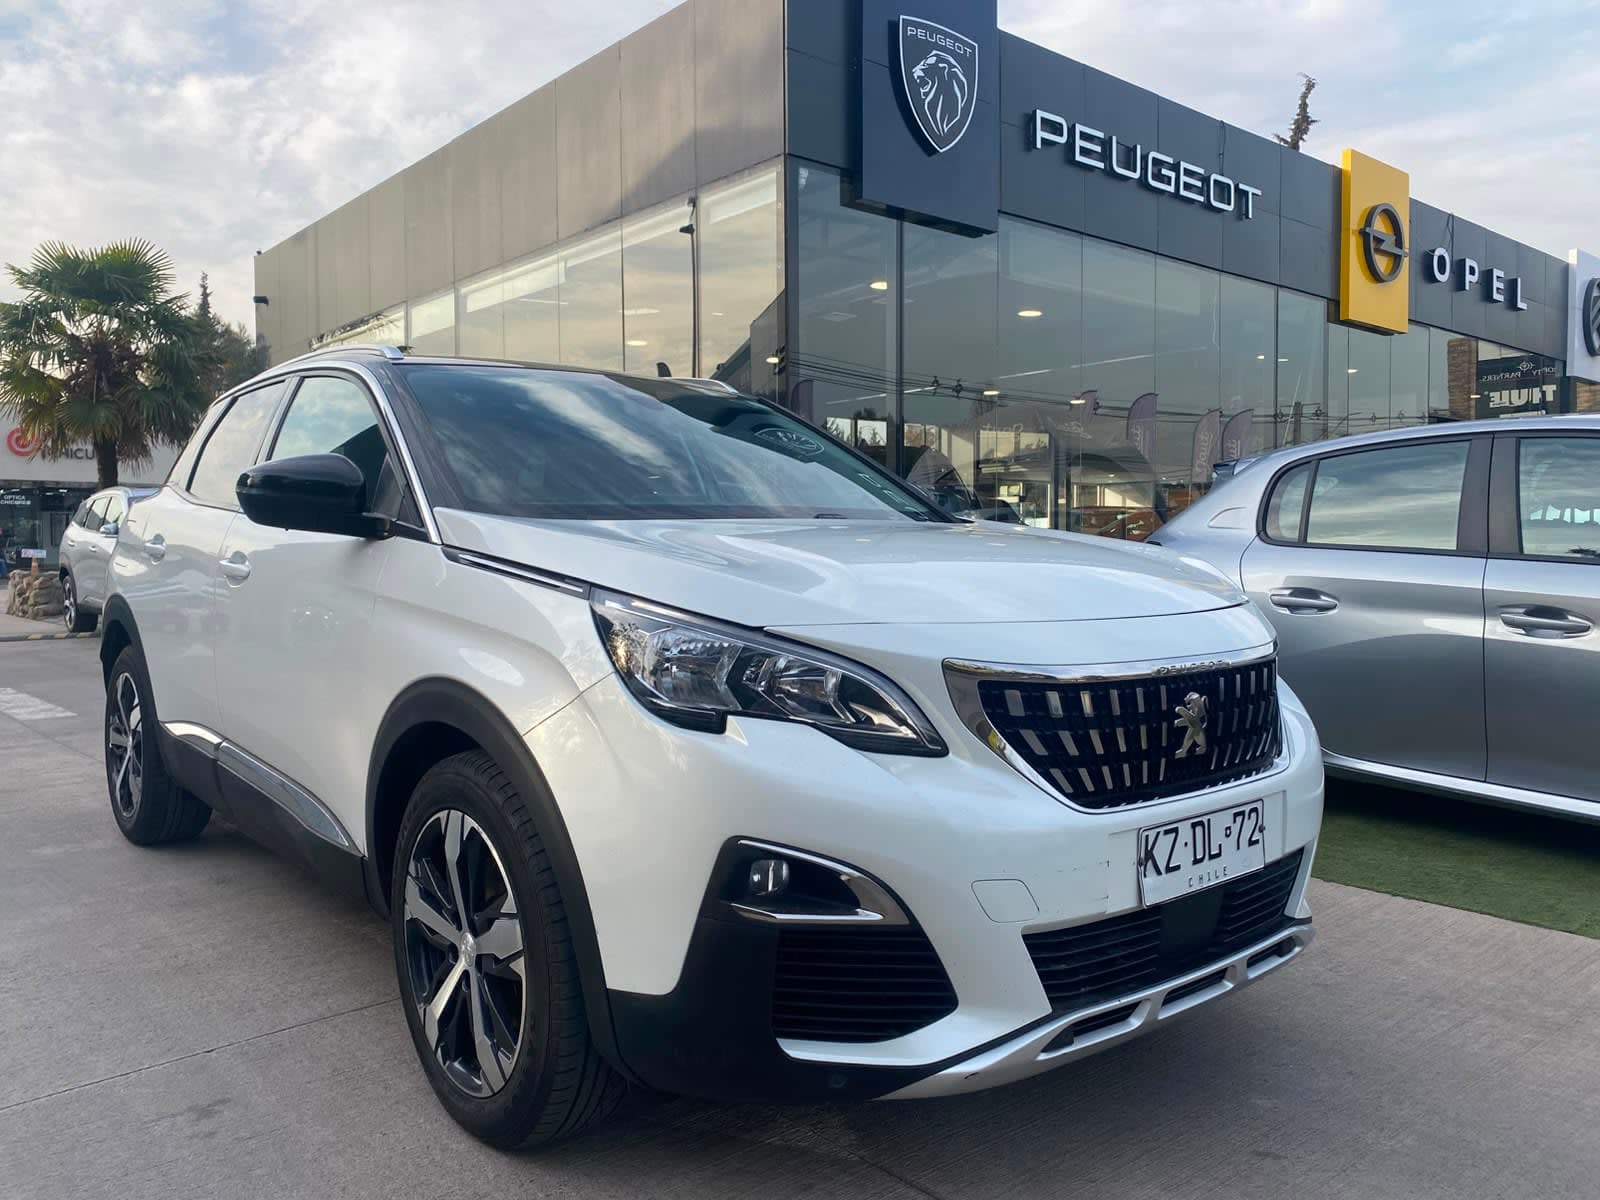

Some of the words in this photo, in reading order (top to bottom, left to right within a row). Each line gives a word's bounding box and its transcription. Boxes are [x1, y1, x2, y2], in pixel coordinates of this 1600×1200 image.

[907, 26, 972, 57] PEUGEOT
[1034, 108, 1262, 219] PEUGEOT
[1431, 246, 1528, 311] OPEL
[1188, 865, 1228, 888] CHILE
